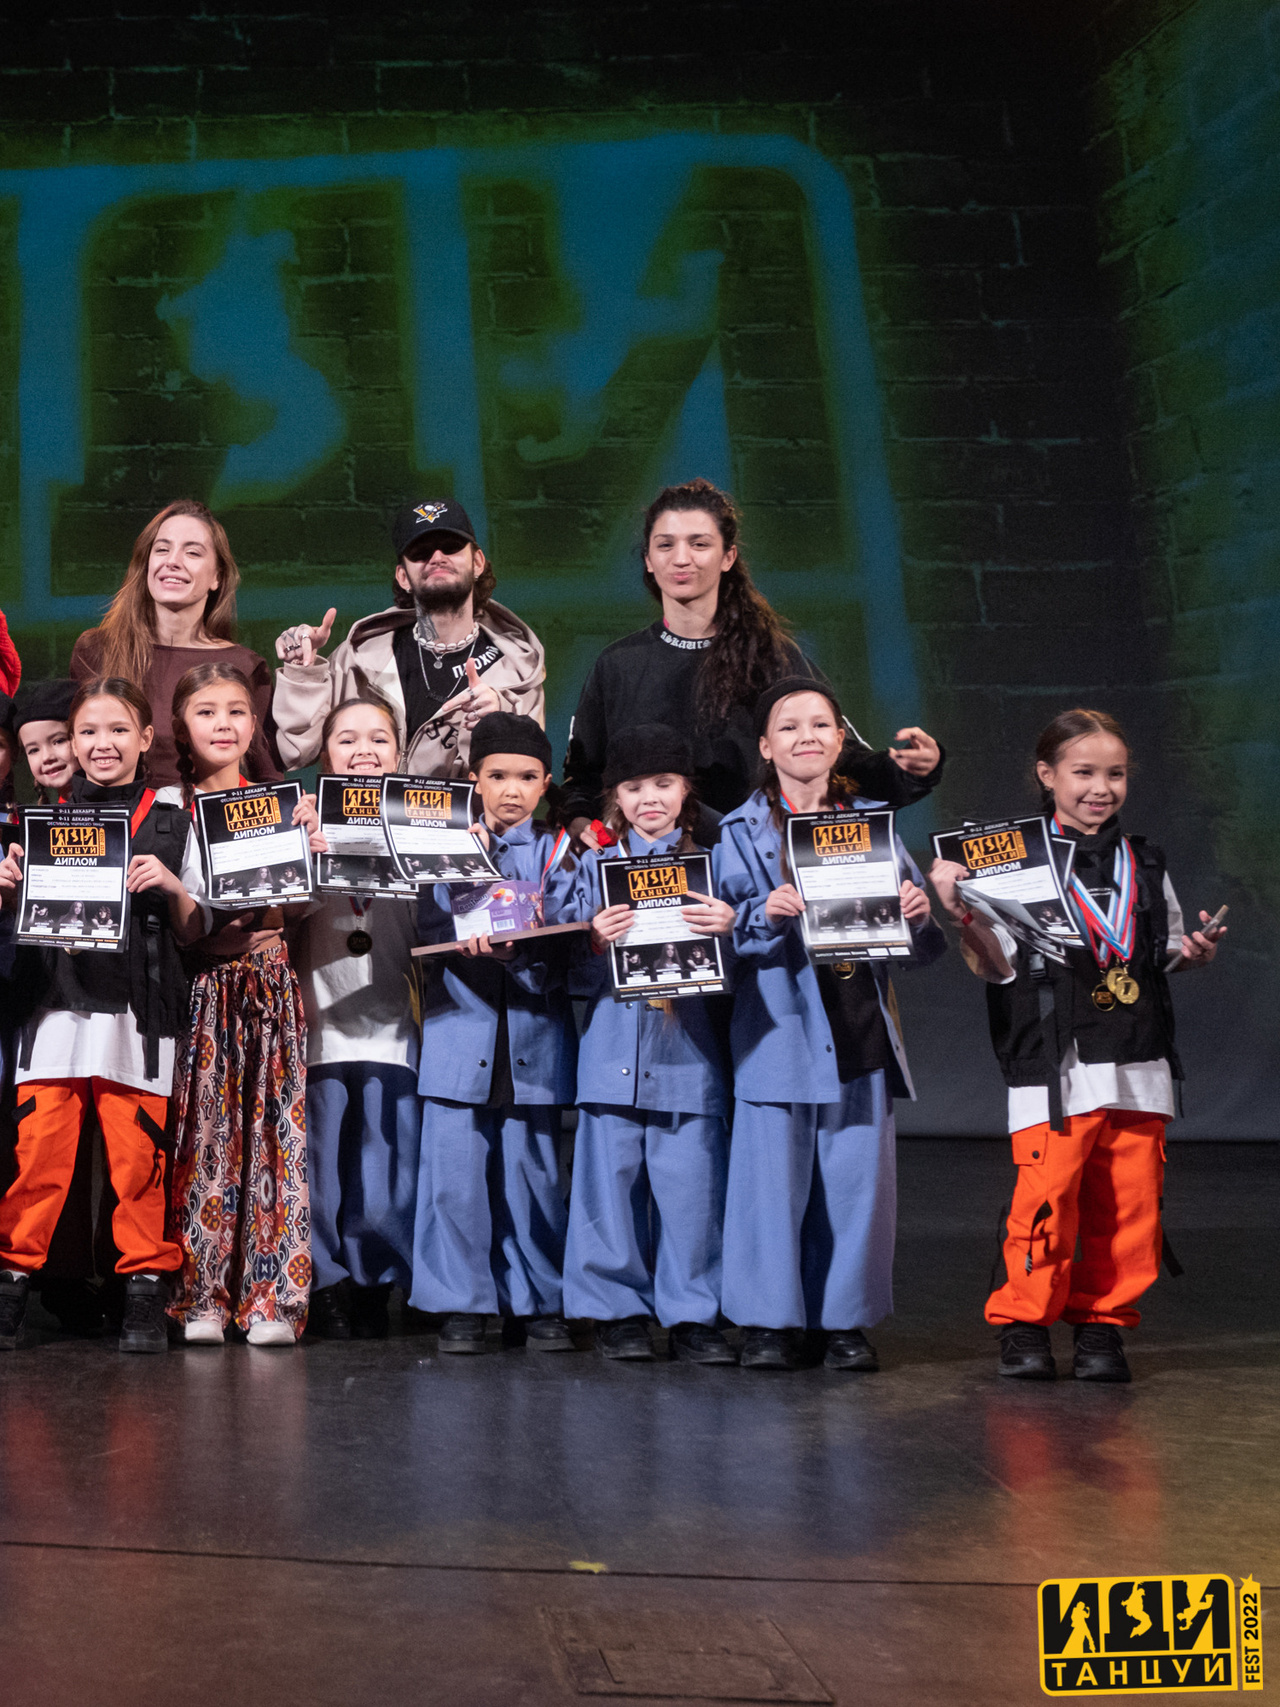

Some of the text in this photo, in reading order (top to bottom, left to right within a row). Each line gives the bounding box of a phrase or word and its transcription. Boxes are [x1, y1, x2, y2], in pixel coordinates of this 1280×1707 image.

[226, 798, 272, 822] ИДИ
[410, 818, 447, 828] ДИПЛОМ
[52, 828, 96, 846] ИДИ
[233, 826, 276, 840] ДИПЛОМ
[54, 857, 98, 866] ДИПЛОМ
[822, 854, 866, 865] ДИПЛОМ
[976, 862, 1022, 877] ДИПЛОМ
[637, 896, 681, 909] ДИПЛОМ
